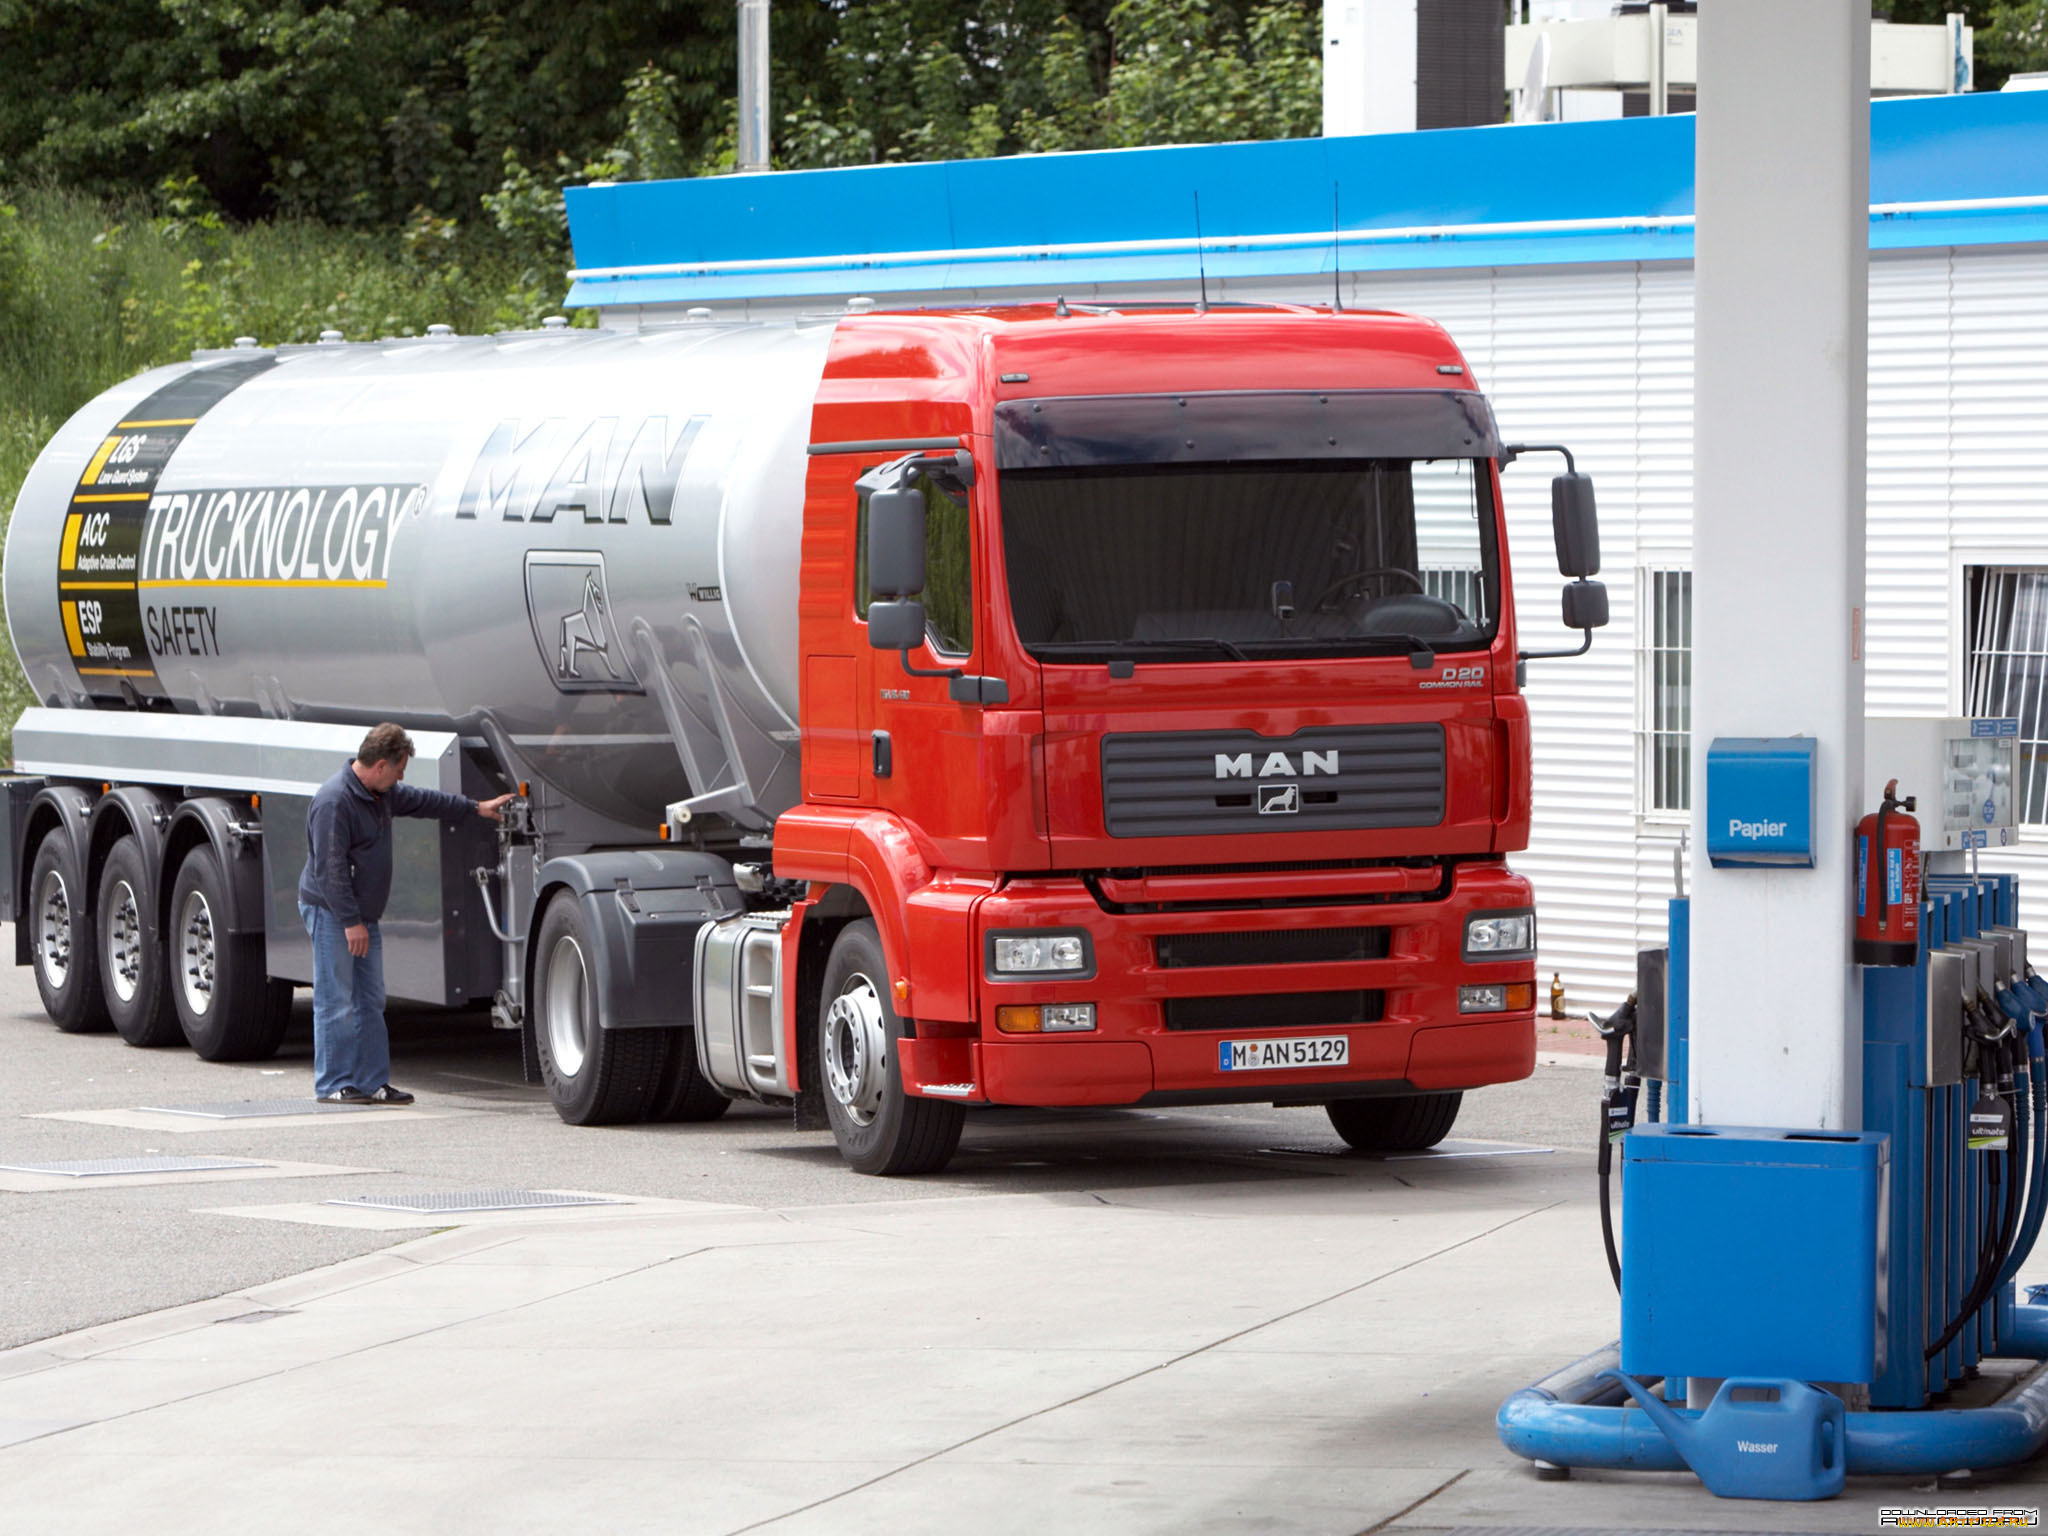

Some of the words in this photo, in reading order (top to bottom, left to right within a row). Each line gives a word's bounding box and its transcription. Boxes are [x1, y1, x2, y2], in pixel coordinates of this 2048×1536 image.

[109, 434, 147, 463] LGS
[455, 414, 712, 526] MAN
[80, 512, 110, 547] ACC
[77, 554, 99, 573] Adaptive
[100, 554, 116, 570] Cruise
[117, 553, 136, 570] Control
[78, 601, 102, 634] ESP
[147, 606, 220, 656] SAFETY
[86, 641, 109, 660] Stability
[106, 642, 131, 660] Program
[1419, 681, 1462, 689] COMMON
[1464, 680, 1483, 688] RAIL
[1215, 750, 1339, 778] MAN
[1729, 819, 1787, 840] Papier
[1233, 1046, 1246, 1066] M
[1294, 1040, 1345, 1062] 5129
[1972, 1127, 2005, 1136] ultimate
[1737, 1440, 1778, 1453] Wasser
